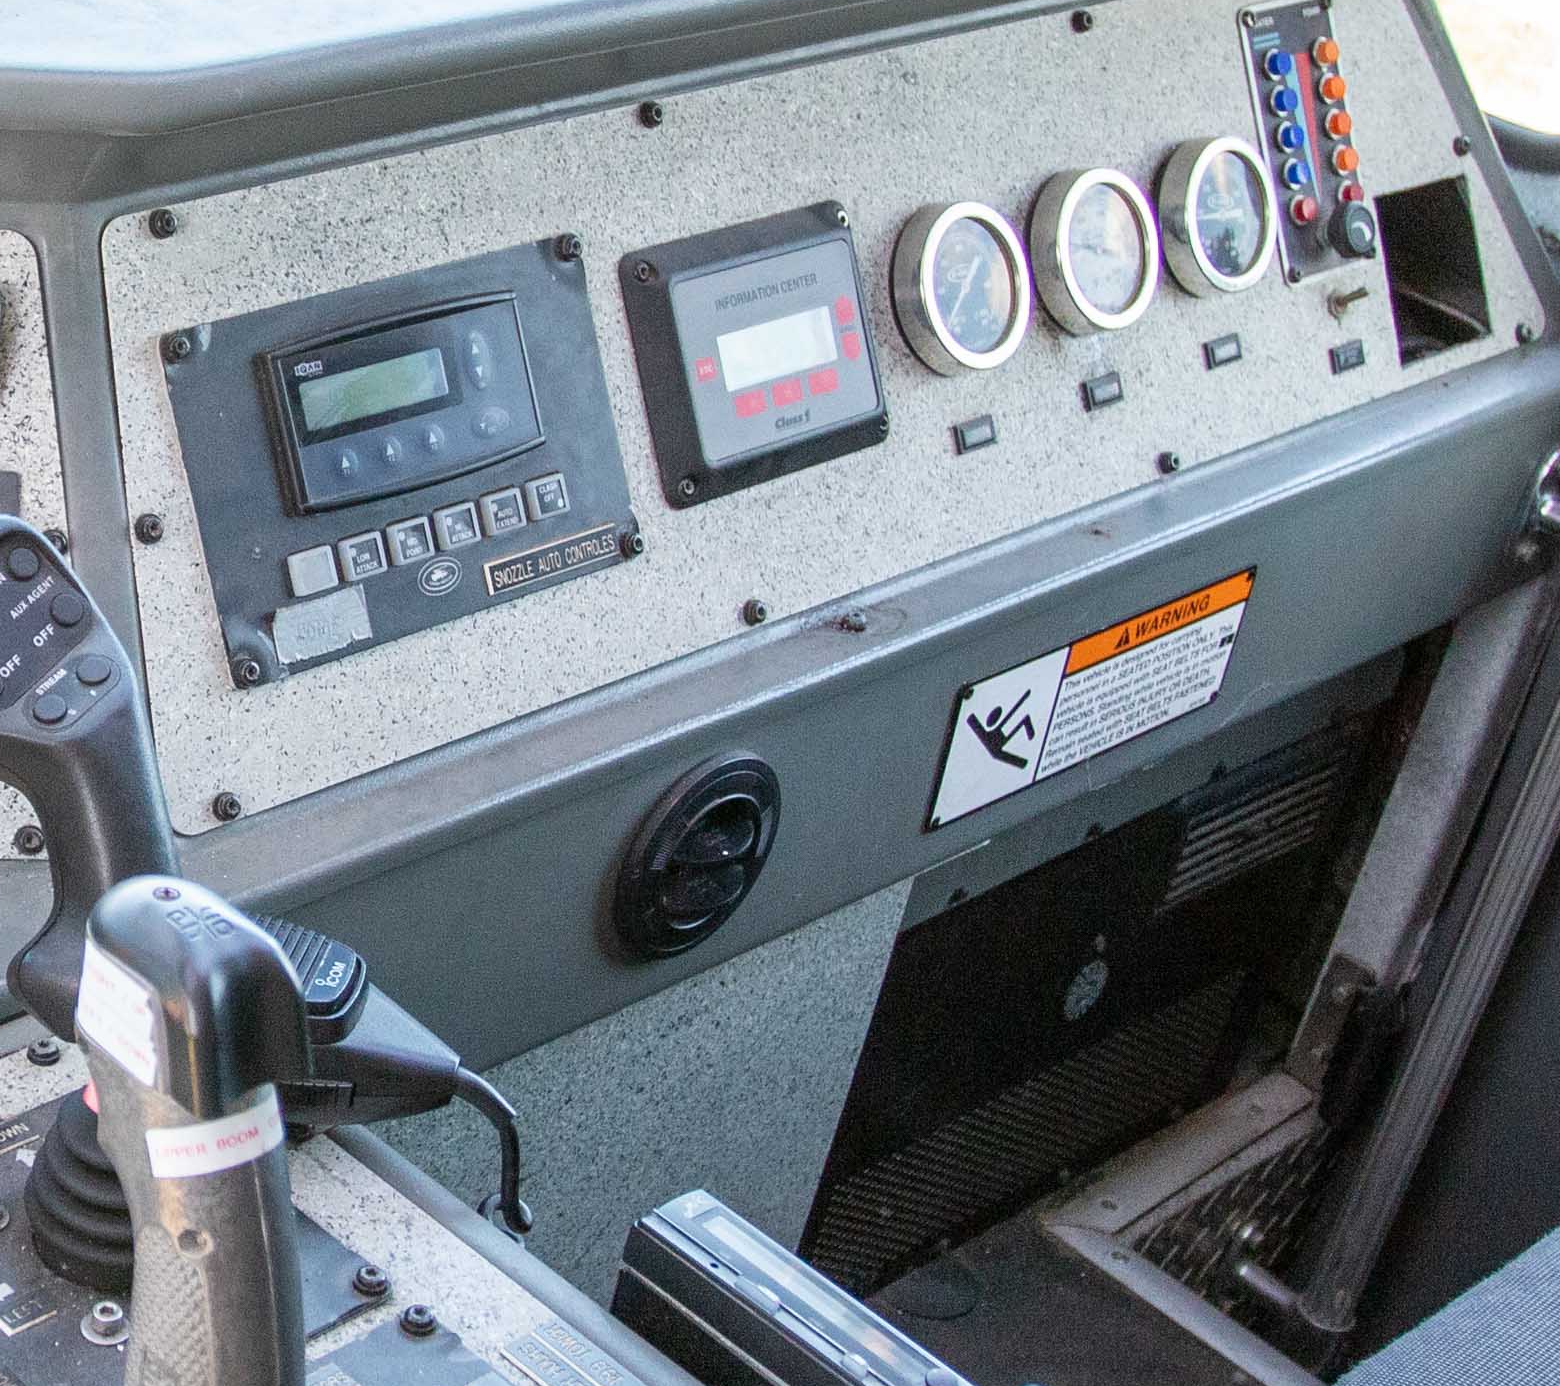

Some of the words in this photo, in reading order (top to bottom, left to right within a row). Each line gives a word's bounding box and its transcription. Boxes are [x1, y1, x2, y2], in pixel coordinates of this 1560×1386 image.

[715, 281, 778, 311] INFORMATION
[779, 273, 818, 294] CENTER
[494, 561, 533, 589] SNOZZLE
[538, 552, 562, 573] AUTO
[565, 534, 615, 564] CONTROLES
[9, 601, 28, 620] AUX
[27, 575, 55, 603] AGENT
[1136, 594, 1211, 638] WARNING
[32, 624, 54, 648] OFF
[0, 654, 22, 678] OFF
[35, 668, 67, 696] STREAM
